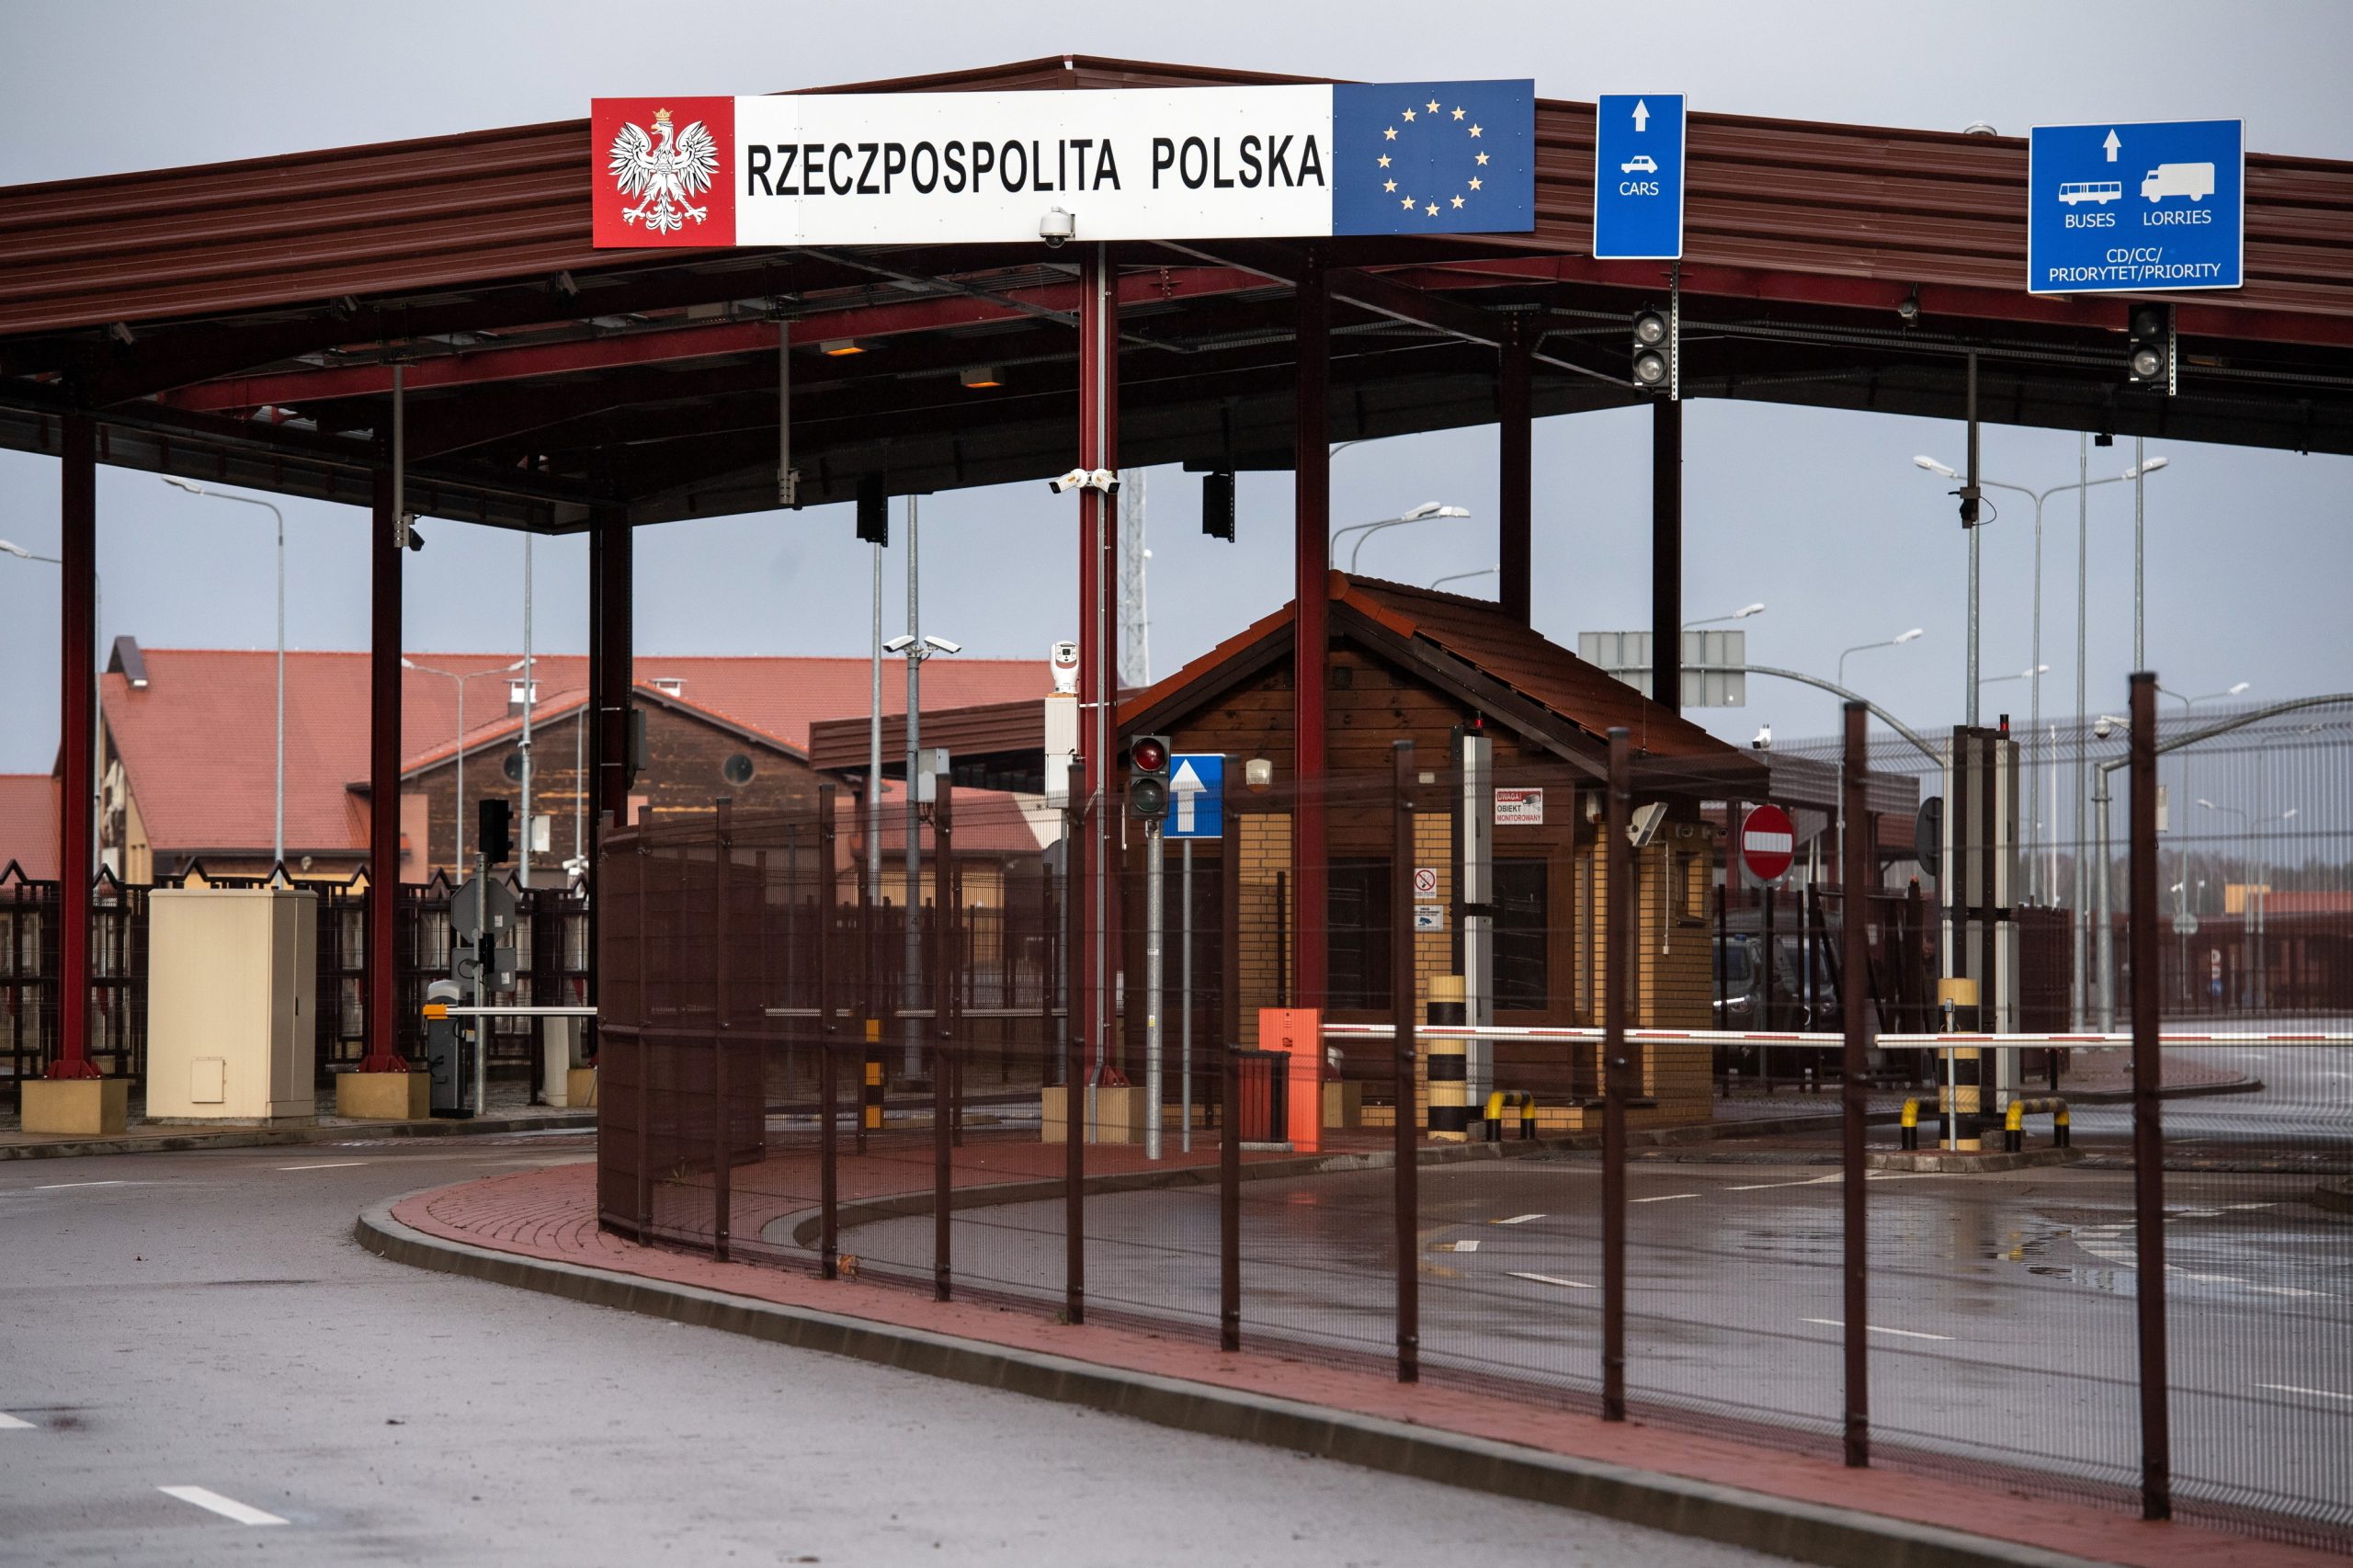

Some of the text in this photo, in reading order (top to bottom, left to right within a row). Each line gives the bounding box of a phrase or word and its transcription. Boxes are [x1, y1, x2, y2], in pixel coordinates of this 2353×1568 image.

[748, 135, 1325, 196] RZECZPOSPOLITA POLSKA
[1619, 182, 1659, 196] CARS
[2065, 210, 2211, 228] BUSES LORRIES
[2106, 247, 2163, 265] CD/CC/
[2049, 263, 2222, 282] PRIORYTET/PRIORITY
